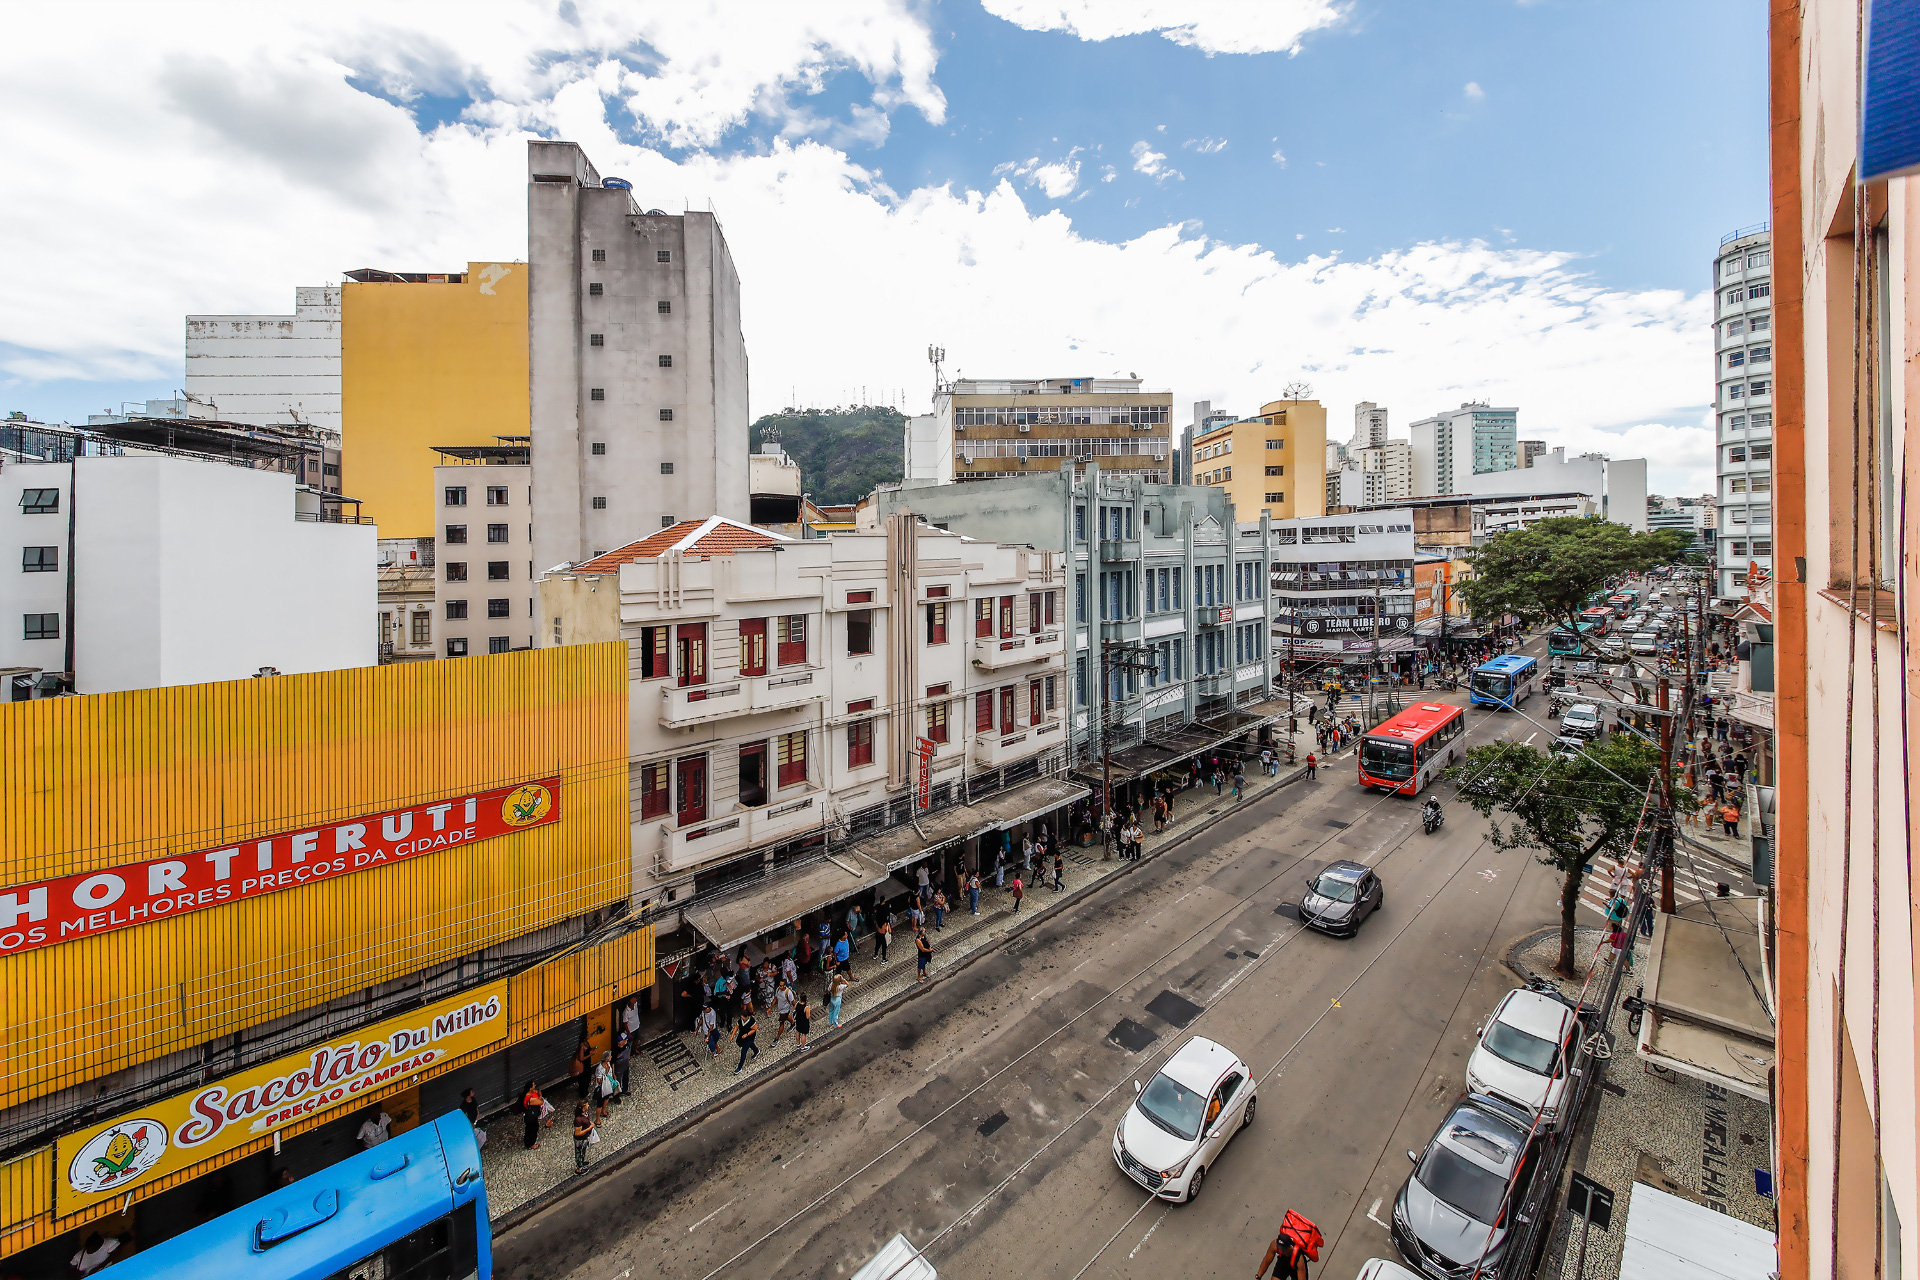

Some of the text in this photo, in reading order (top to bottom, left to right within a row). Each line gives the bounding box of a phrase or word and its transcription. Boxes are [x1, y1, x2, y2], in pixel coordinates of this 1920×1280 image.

[1325, 617, 1391, 628] TEAM RIBERO
[0, 797, 478, 930] HORTIFRUTI
[0, 826, 477, 950] OS MELHORES PREÇOS DA CIDADE
[178, 998, 498, 1145] Sacolão Du Milhó
[265, 1050, 435, 1128] PREÇÃO CAMPEÃO
[646, 1033, 704, 1092] HOTEL
